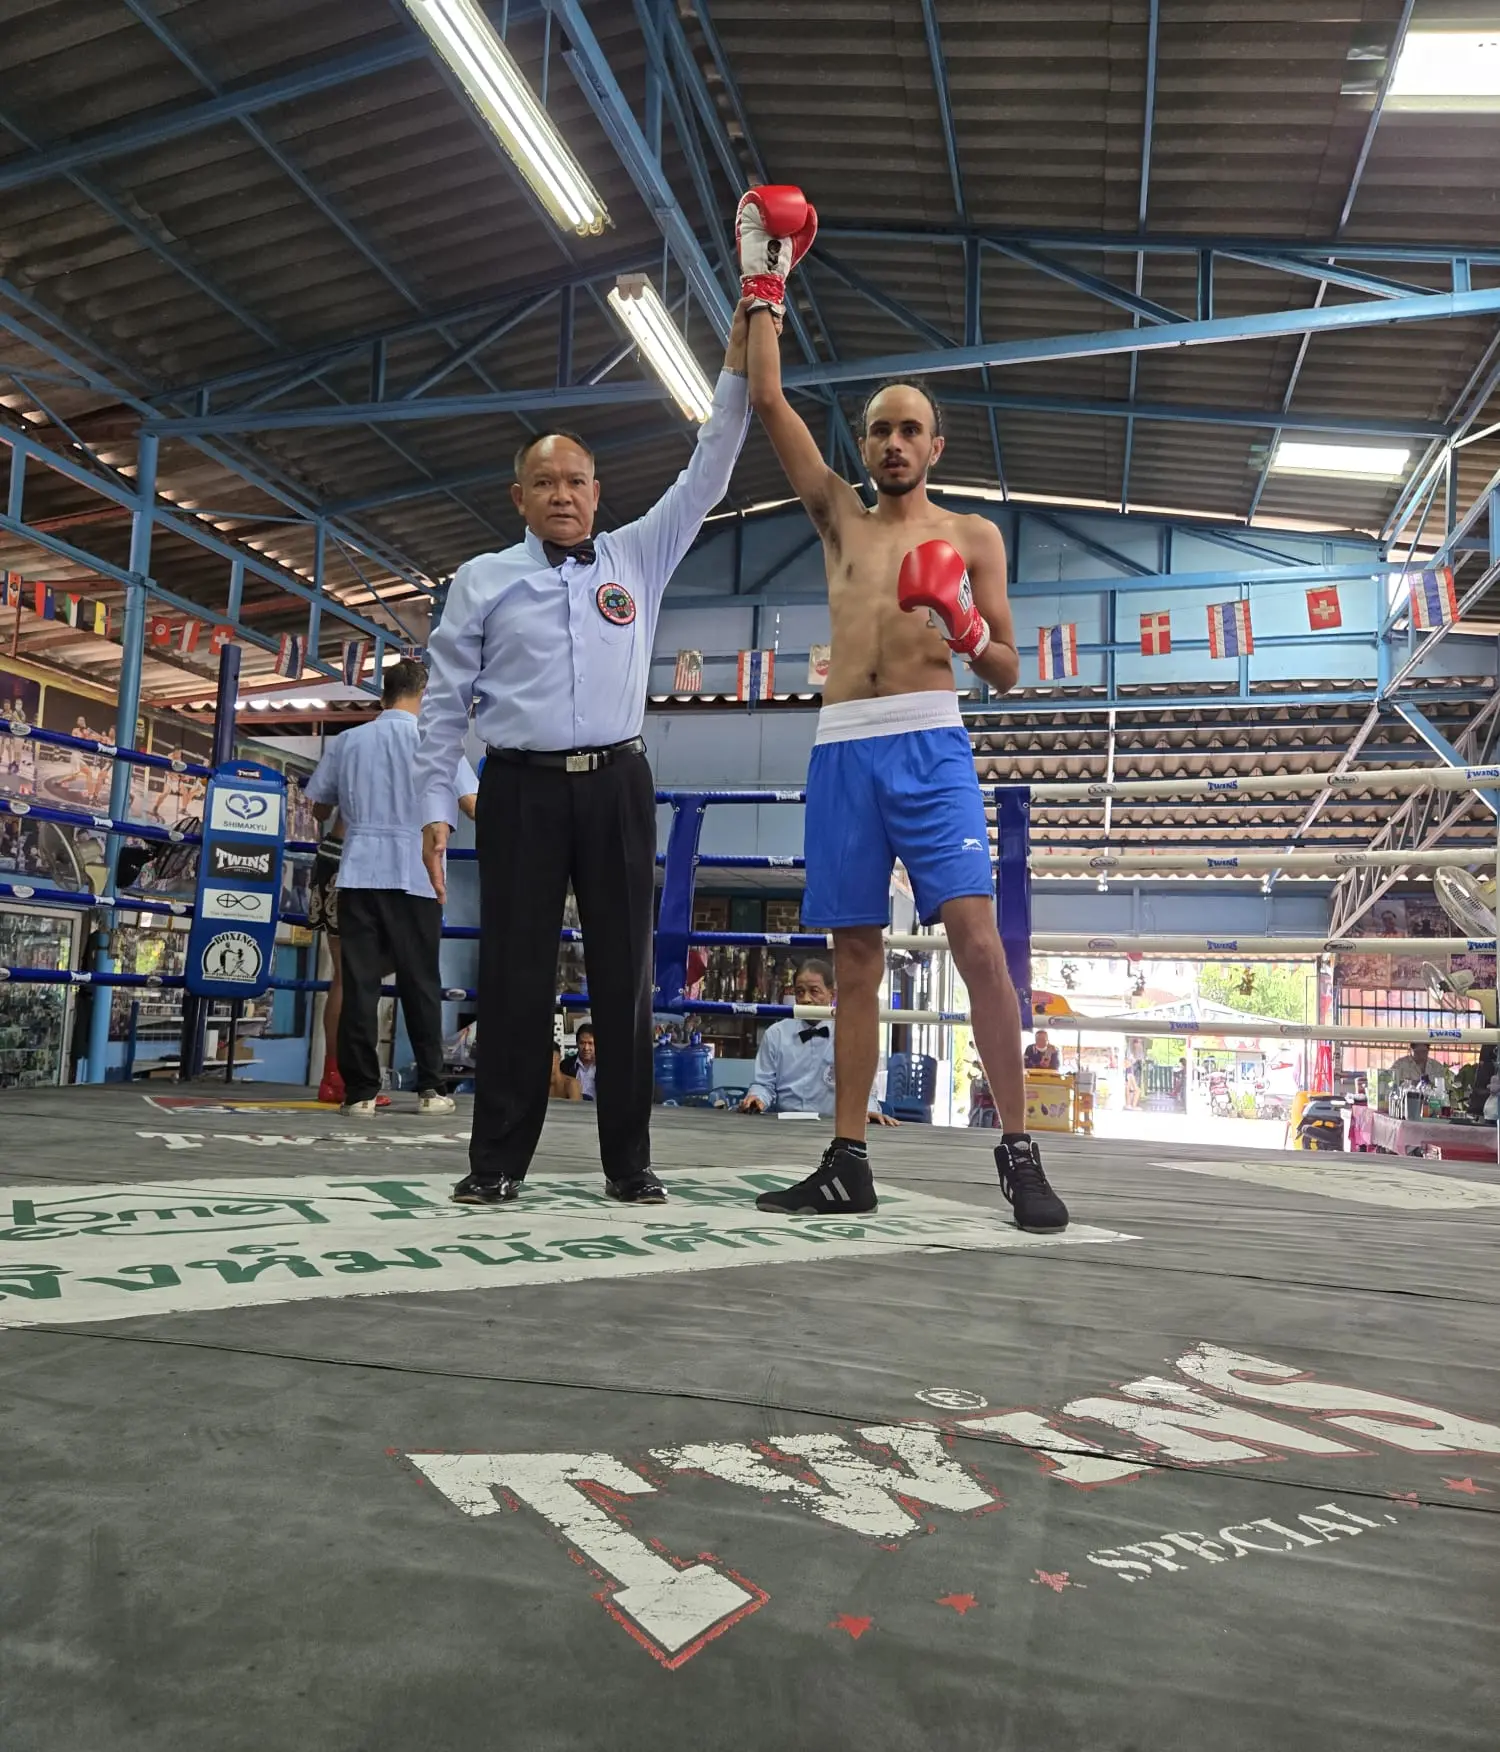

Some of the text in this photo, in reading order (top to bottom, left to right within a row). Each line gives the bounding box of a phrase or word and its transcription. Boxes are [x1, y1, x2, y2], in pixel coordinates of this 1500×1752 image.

[1207, 780, 1238, 791] TWINS
[223, 820, 268, 832] SHIMAKYU
[215, 847, 270, 873] TWINS
[1207, 857, 1238, 868] TWINS
[213, 932, 255, 948] BOXING
[1207, 940, 1238, 951] TWINS
[1467, 940, 1497, 951] TWIN
[1169, 1021, 1200, 1031] TWINS
[402, 1341, 1500, 1666] TWINS
[1087, 1502, 1398, 1582] SPECIAL
